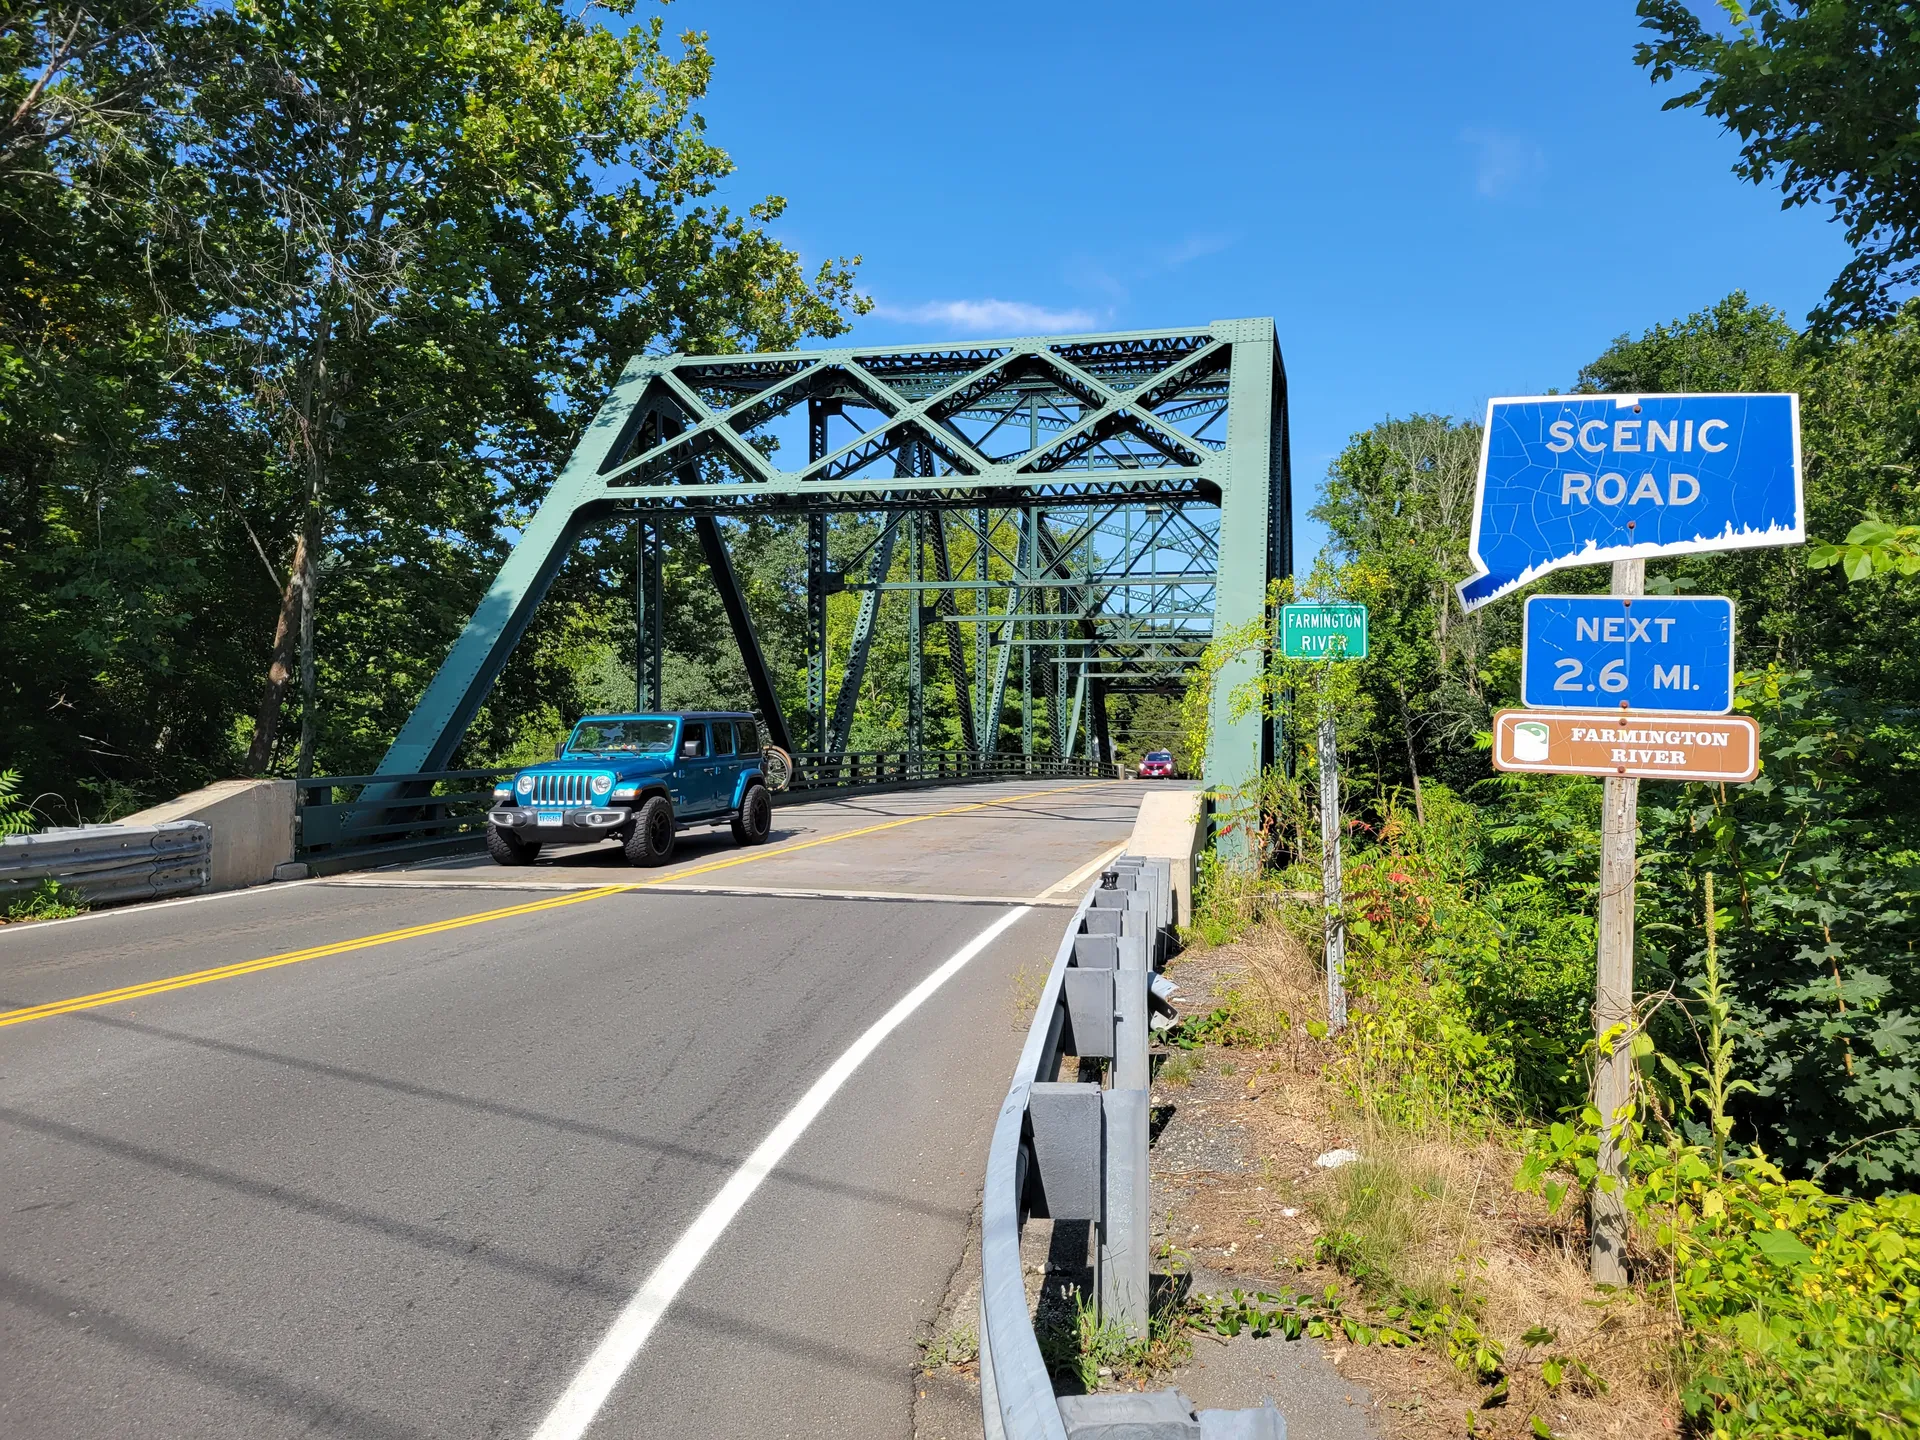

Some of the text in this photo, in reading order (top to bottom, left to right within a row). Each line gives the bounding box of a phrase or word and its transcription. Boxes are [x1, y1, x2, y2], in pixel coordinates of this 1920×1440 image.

[1545, 420, 1729, 453] SCENIC
[1561, 473, 1701, 506] ROAD
[1288, 613, 1361, 628] FARMINGTON
[1576, 617, 1676, 643] NEXT
[1553, 659, 1700, 693] 2.6 MI.
[1571, 728, 1730, 747] FARMINGTON
[1611, 748, 1686, 765] RIVER
